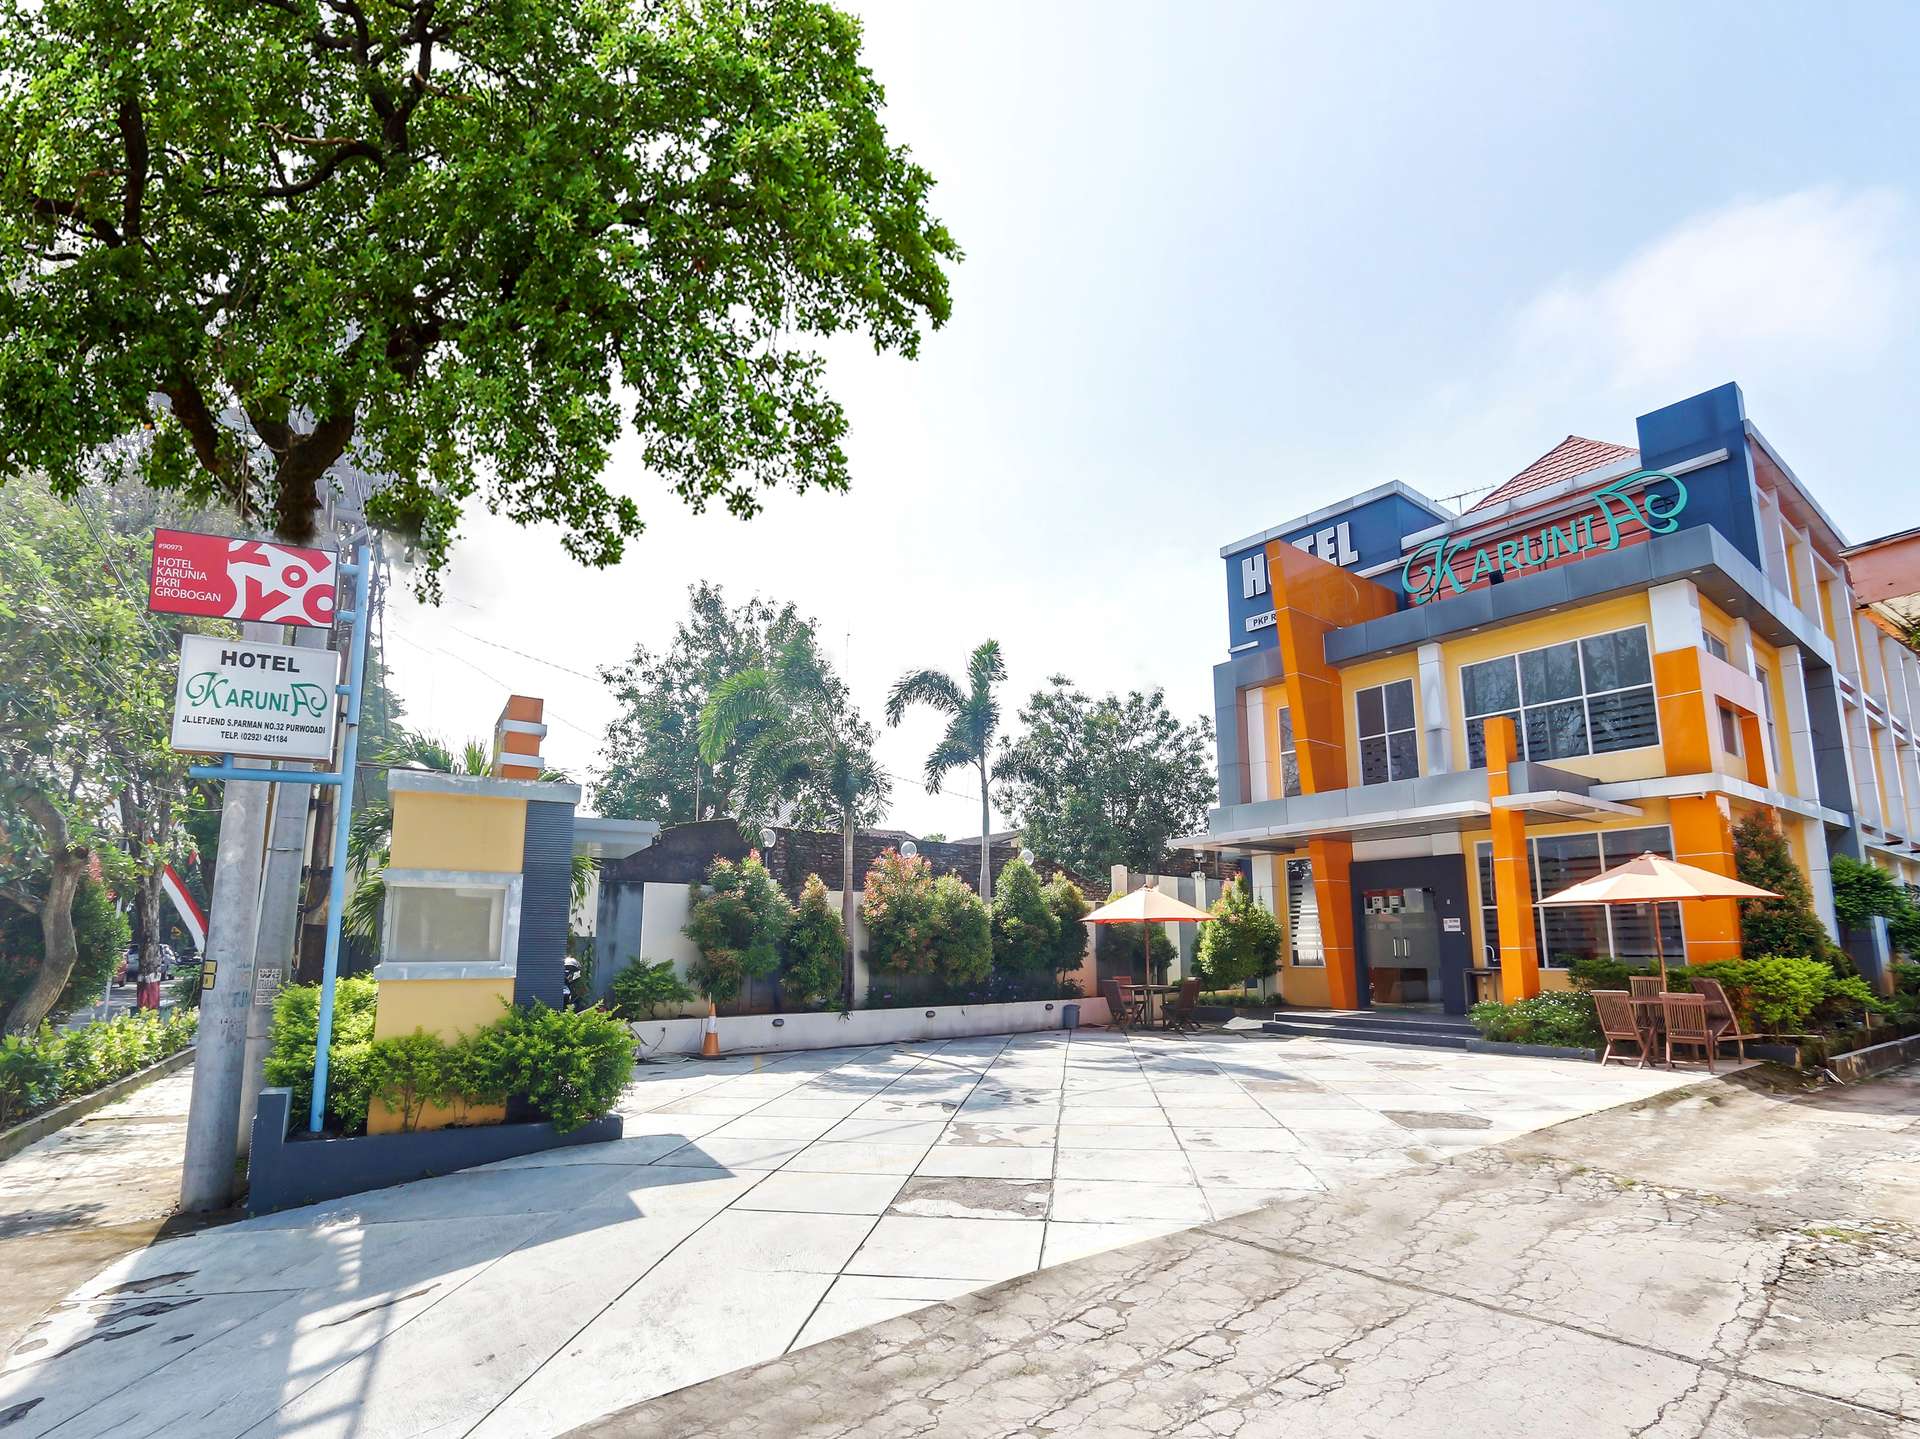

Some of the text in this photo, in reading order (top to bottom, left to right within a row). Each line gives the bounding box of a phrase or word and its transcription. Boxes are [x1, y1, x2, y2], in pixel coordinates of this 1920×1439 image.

[1401, 470, 1688, 605] KARUNIA
[157, 557, 194, 570] HOTEL
[1241, 521, 1359, 599] HTEL
[156, 566, 207, 580] KARUNIA
[155, 577, 180, 588] PKRI
[154, 587, 221, 602] GROBOGAN
[1253, 616, 1269, 627] PKP
[220, 650, 300, 673] HOTEL
[185, 671, 328, 718] KARUNIA
[227, 719, 263, 729] S.PARMAN
[264, 722, 285, 731] NO.32
[285, 724, 326, 734] PURWODADI
[220, 730, 288, 743] TELP. (0292) 421184
